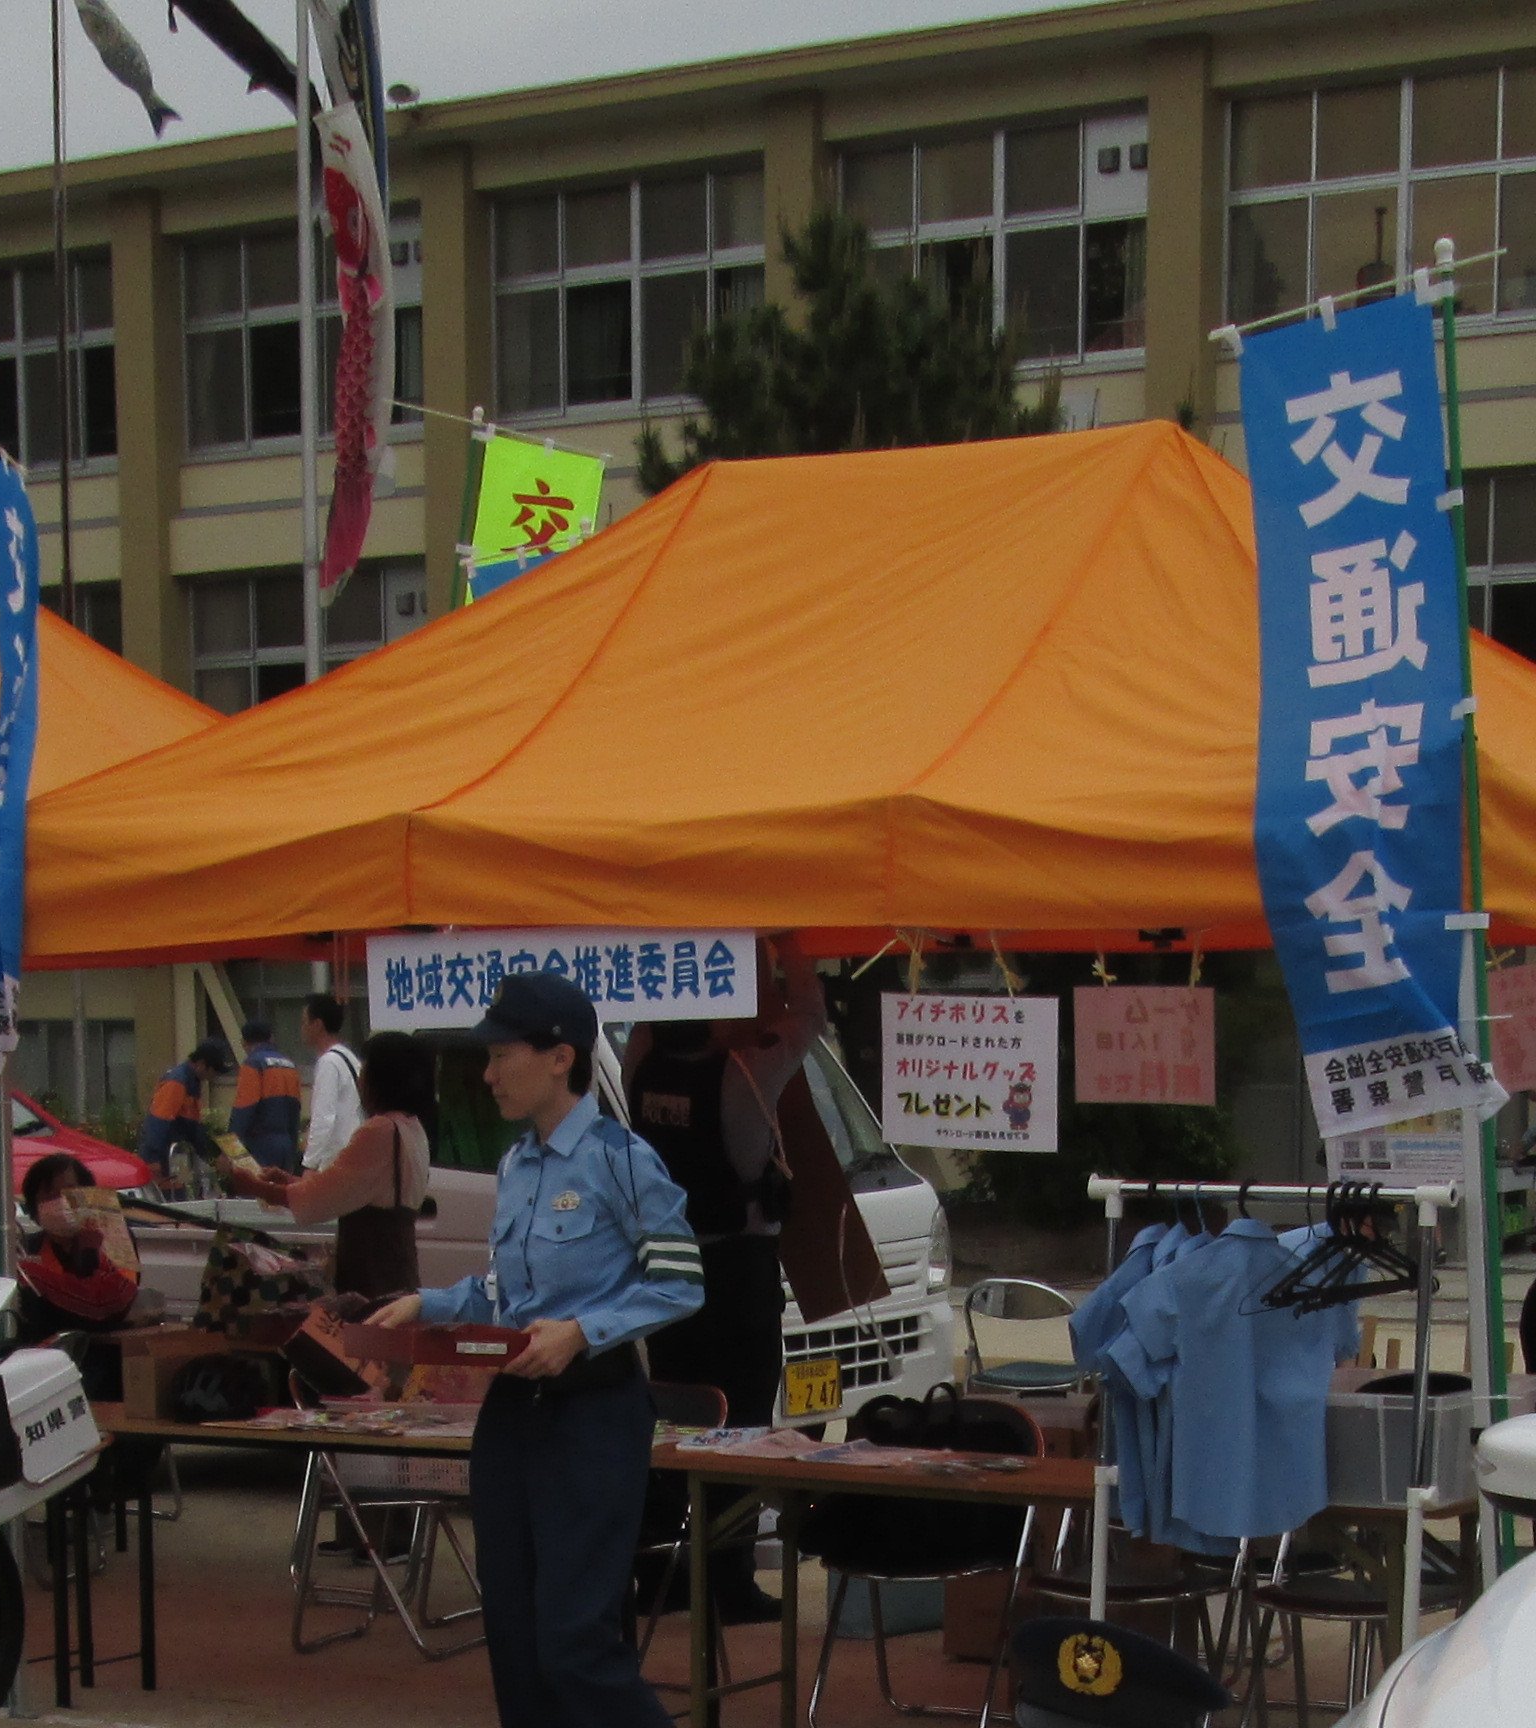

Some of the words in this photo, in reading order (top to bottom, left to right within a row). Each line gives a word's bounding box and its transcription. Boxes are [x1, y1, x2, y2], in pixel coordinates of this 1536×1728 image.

[500, 477, 575, 556] 交
[896, 1000, 1026, 1025] アイチポリスを
